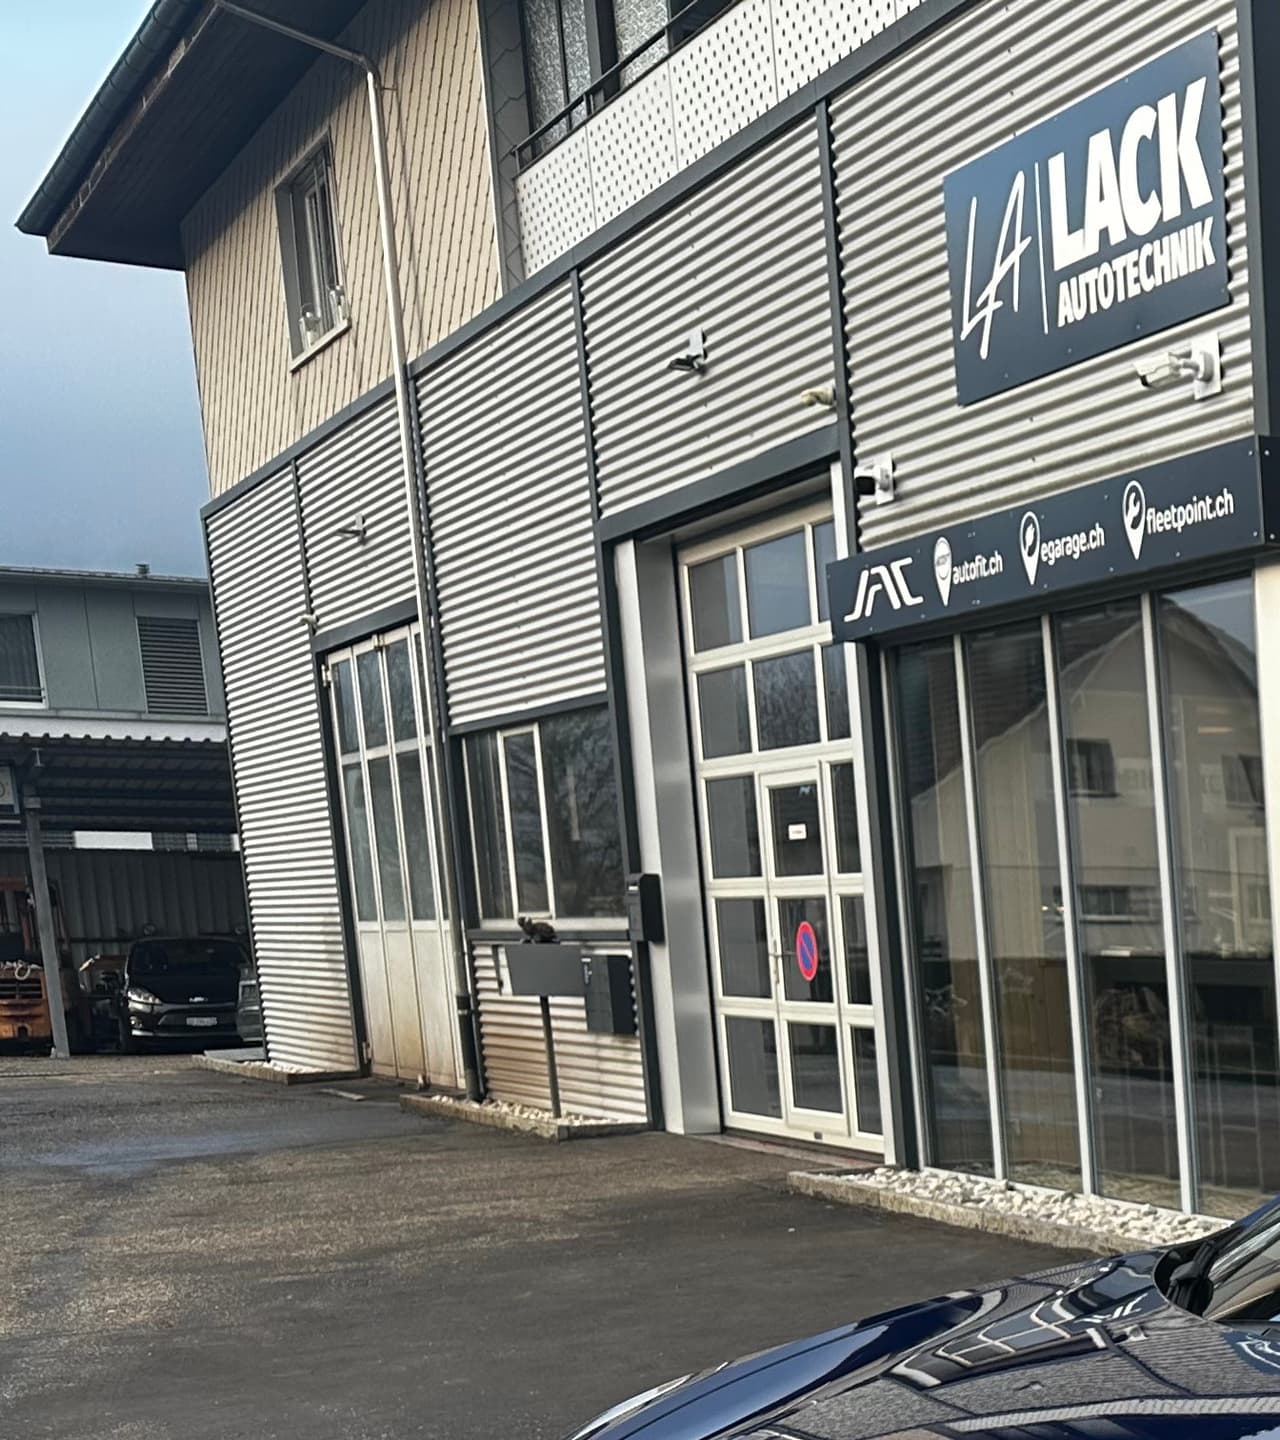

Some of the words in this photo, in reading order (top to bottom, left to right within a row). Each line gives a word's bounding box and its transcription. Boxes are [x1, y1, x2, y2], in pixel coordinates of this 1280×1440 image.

[1047, 76, 1216, 271] LACK
[961, 170, 1032, 360] LA
[1056, 216, 1217, 328] AUTOTECHNIK
[1039, 522, 1105, 566] egarage.ch
[1146, 487, 1234, 535] fleetpoint.ch
[951, 549, 1004, 585] autofit.ch
